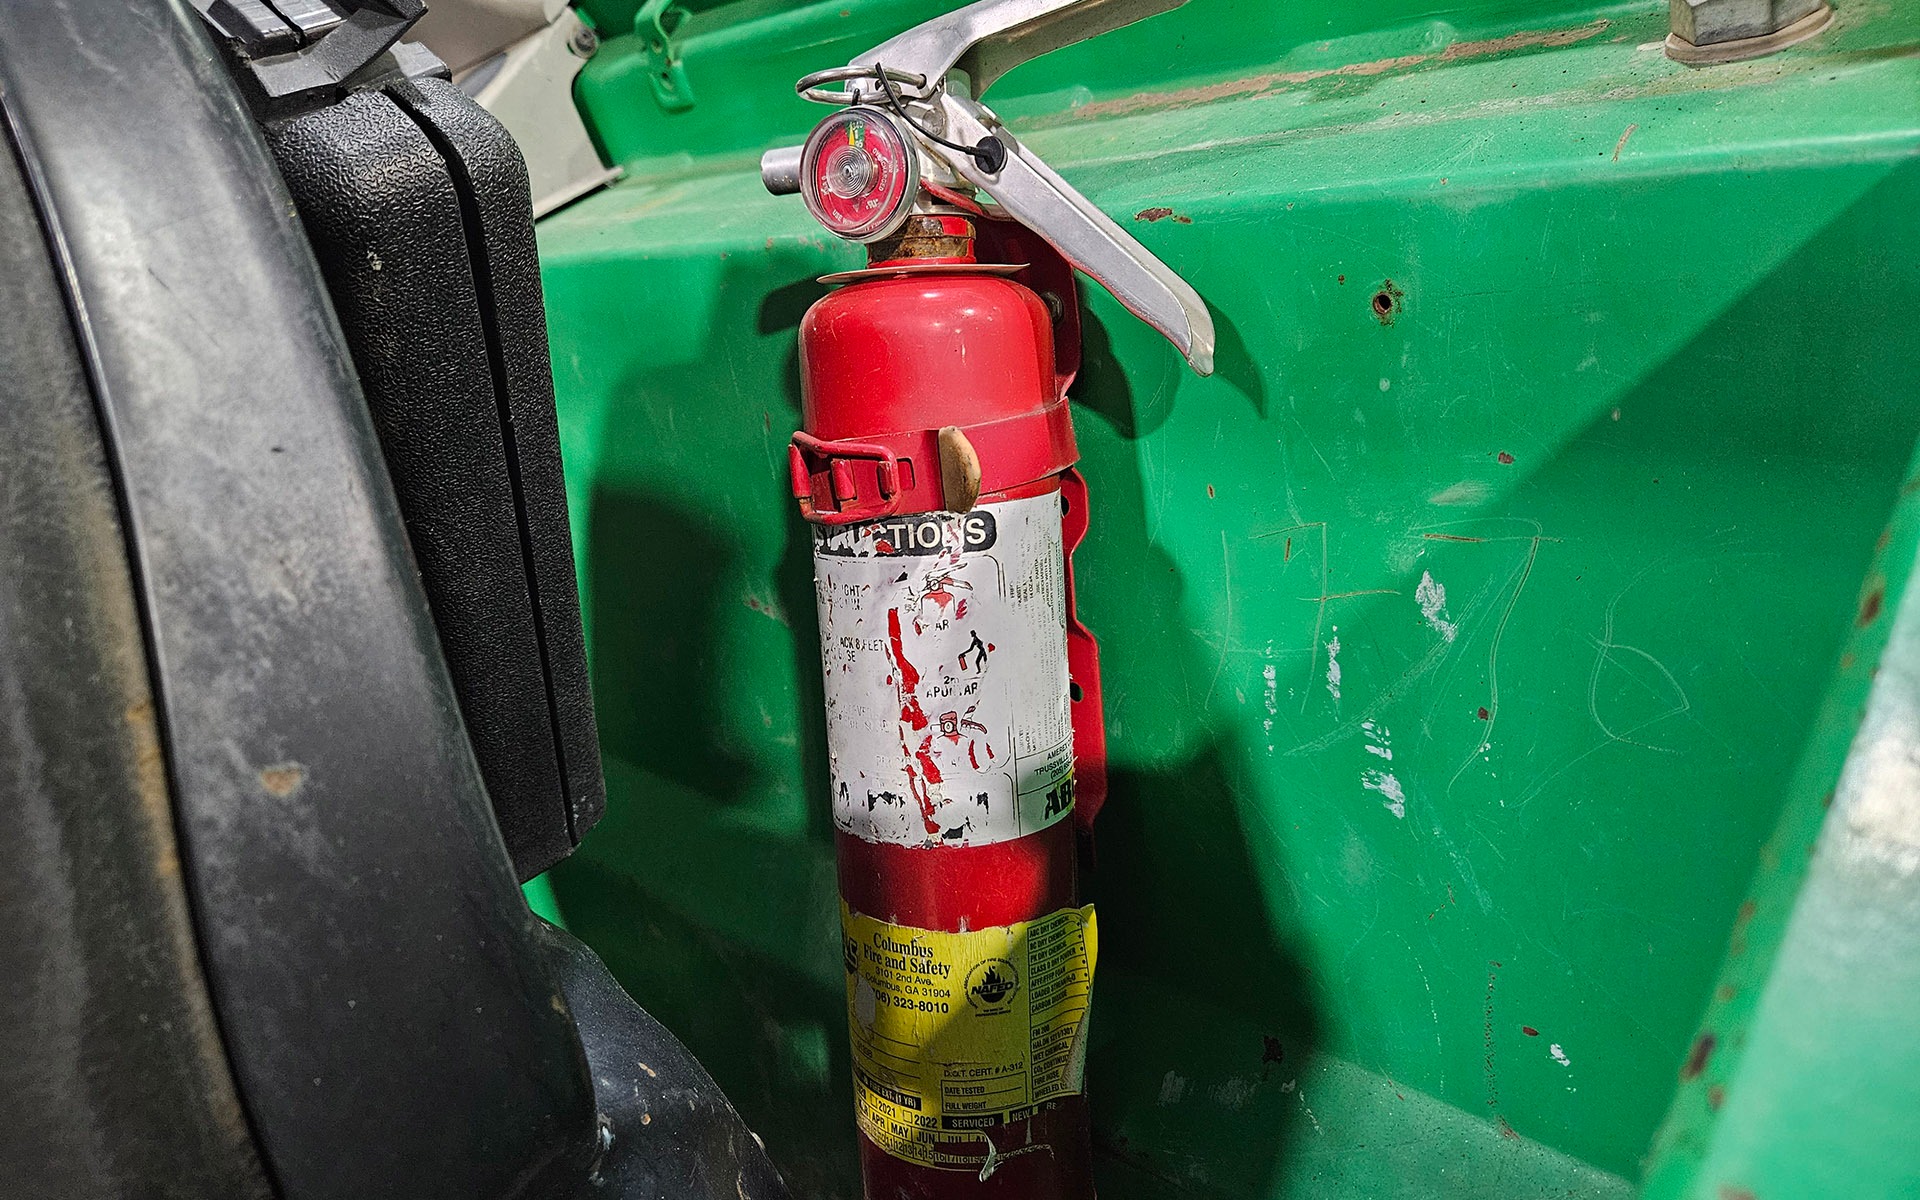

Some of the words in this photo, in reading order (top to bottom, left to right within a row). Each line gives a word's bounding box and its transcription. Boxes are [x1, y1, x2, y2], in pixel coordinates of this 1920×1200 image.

[1044, 778, 1073, 820] AB
[873, 932, 934, 958] Columbus
[863, 943, 882, 965] Fire
[885, 955, 906, 972] and
[910, 956, 951, 979] Safety
[1031, 963, 1046, 975] CLASS
[865, 972, 902, 994] Columbus,
[905, 986, 919, 996] GA
[922, 987, 951, 998] 31904
[875, 966, 893, 980] 3101
[896, 973, 912, 984] 2nd
[914, 976, 934, 987] Ave.
[971, 981, 1014, 995] NAFED
[872, 988, 891, 1007] 06)
[893, 995, 949, 1014] 323-8010
[969, 1067, 993, 1077] CERT.
[1002, 1061, 1024, 1072] A-312
[961, 1086, 985, 1094] TESTED
[878, 1101, 896, 1118] 2021
[914, 1115, 938, 1128] 2022
[945, 1102, 961, 1110] FULL
[962, 1101, 986, 1110] WEIGHT
[952, 1117, 994, 1128] SERVICED
[1012, 1108, 1030, 1122] NEW
[872, 1113, 885, 1128] APR
[891, 1123, 909, 1139] MAY
[917, 1132, 935, 1144] JUN
[895, 1138, 903, 1150] 12
[905, 1142, 913, 1154] 13
